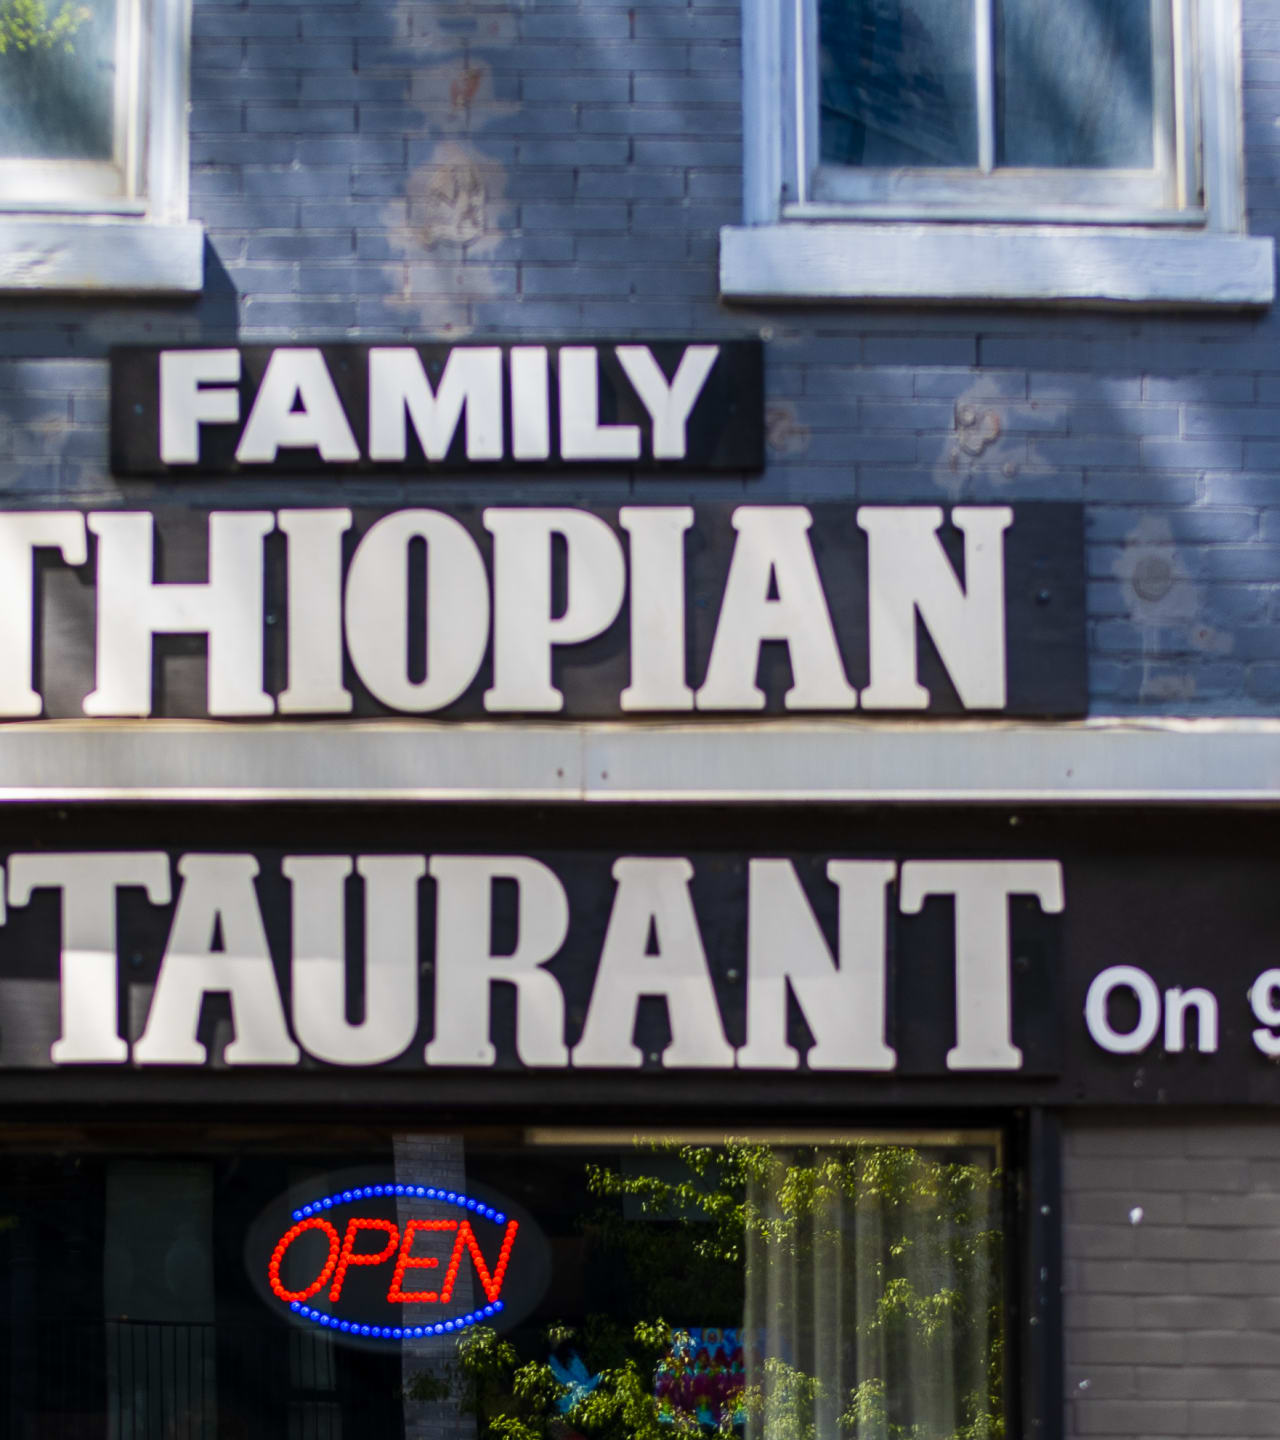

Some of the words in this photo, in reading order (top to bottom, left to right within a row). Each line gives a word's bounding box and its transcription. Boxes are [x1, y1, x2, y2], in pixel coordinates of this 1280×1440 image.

[158, 345, 719, 464] FAMILY
[1084, 964, 1219, 1055] On
[269, 1217, 519, 1303] OPEN
